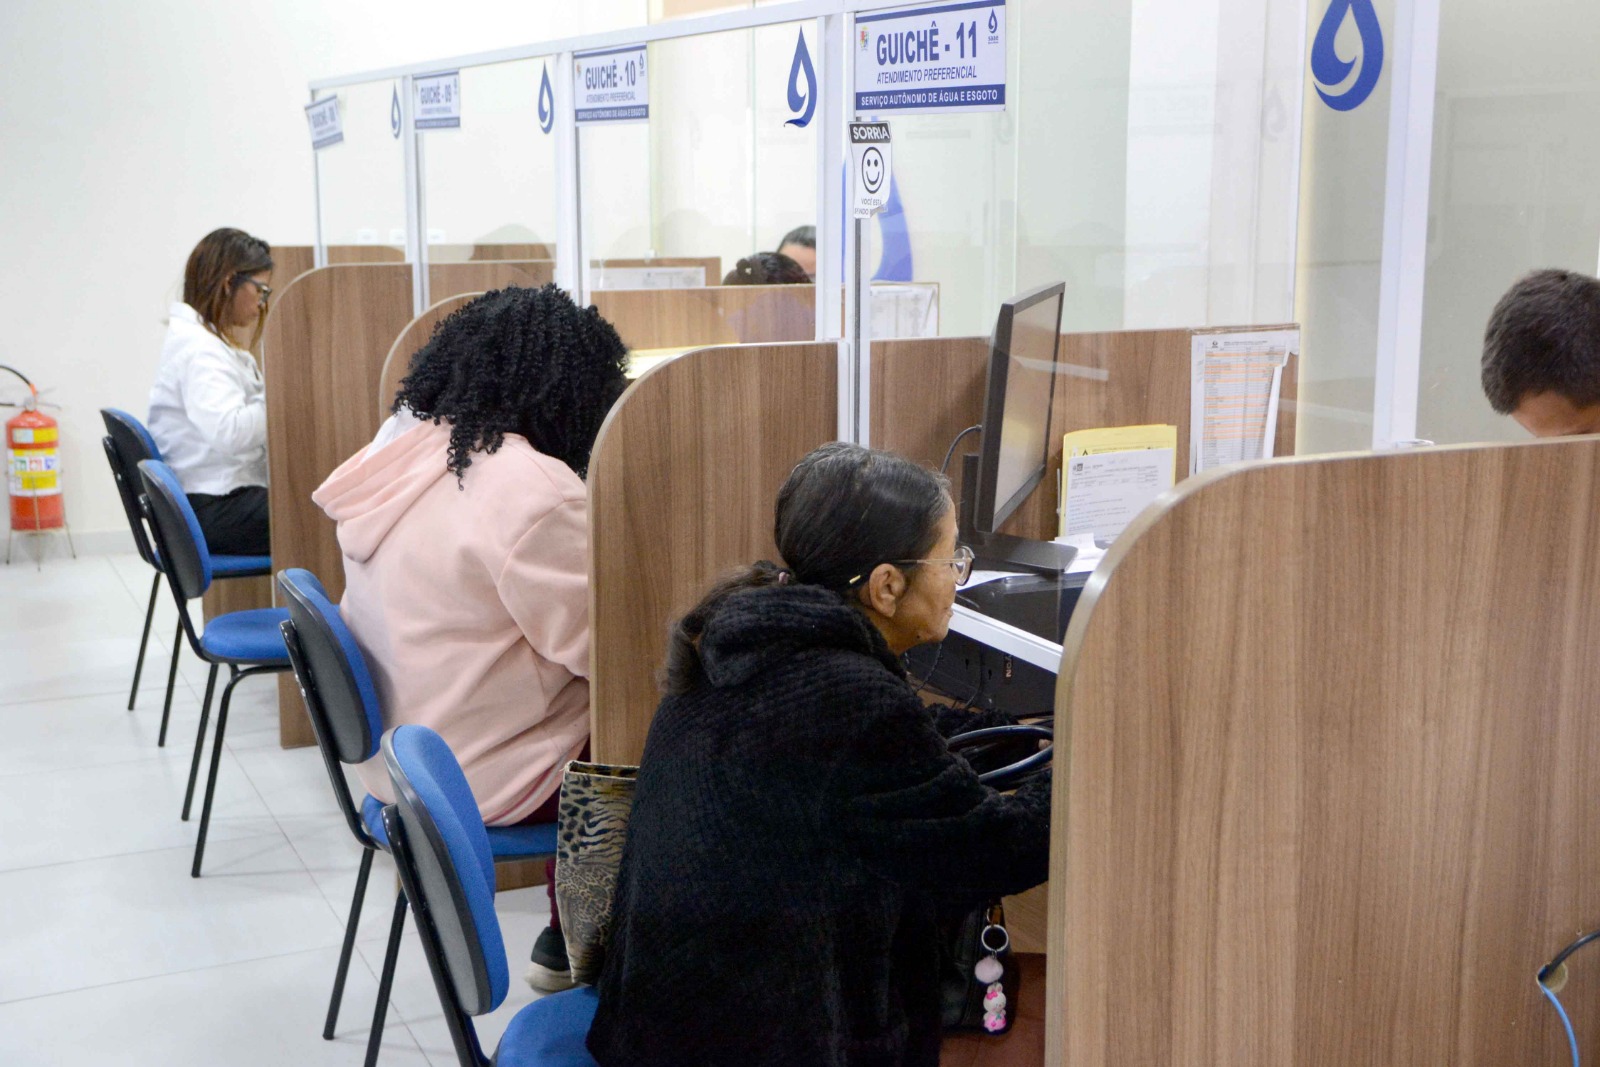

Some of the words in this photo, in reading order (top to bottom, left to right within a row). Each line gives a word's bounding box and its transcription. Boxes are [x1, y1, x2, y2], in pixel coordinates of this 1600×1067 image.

[876, 20, 940, 66] GUICHÊ
[956, 20, 978, 59] 11
[586, 59, 617, 89] GUICHÊ
[624, 60, 636, 87] 10
[876, 68, 923, 84] ATENDIMENTO
[923, 65, 978, 81] PREFERENCIAL
[861, 94, 889, 108] SERVIÇO
[889, 91, 927, 105] AUTÔNOMO
[928, 92, 938, 103] DE
[938, 89, 959, 103] ÁGUA
[960, 91, 966, 102] E
[966, 89, 998, 101] ESGOTO
[853, 126, 890, 140] SORRIA
